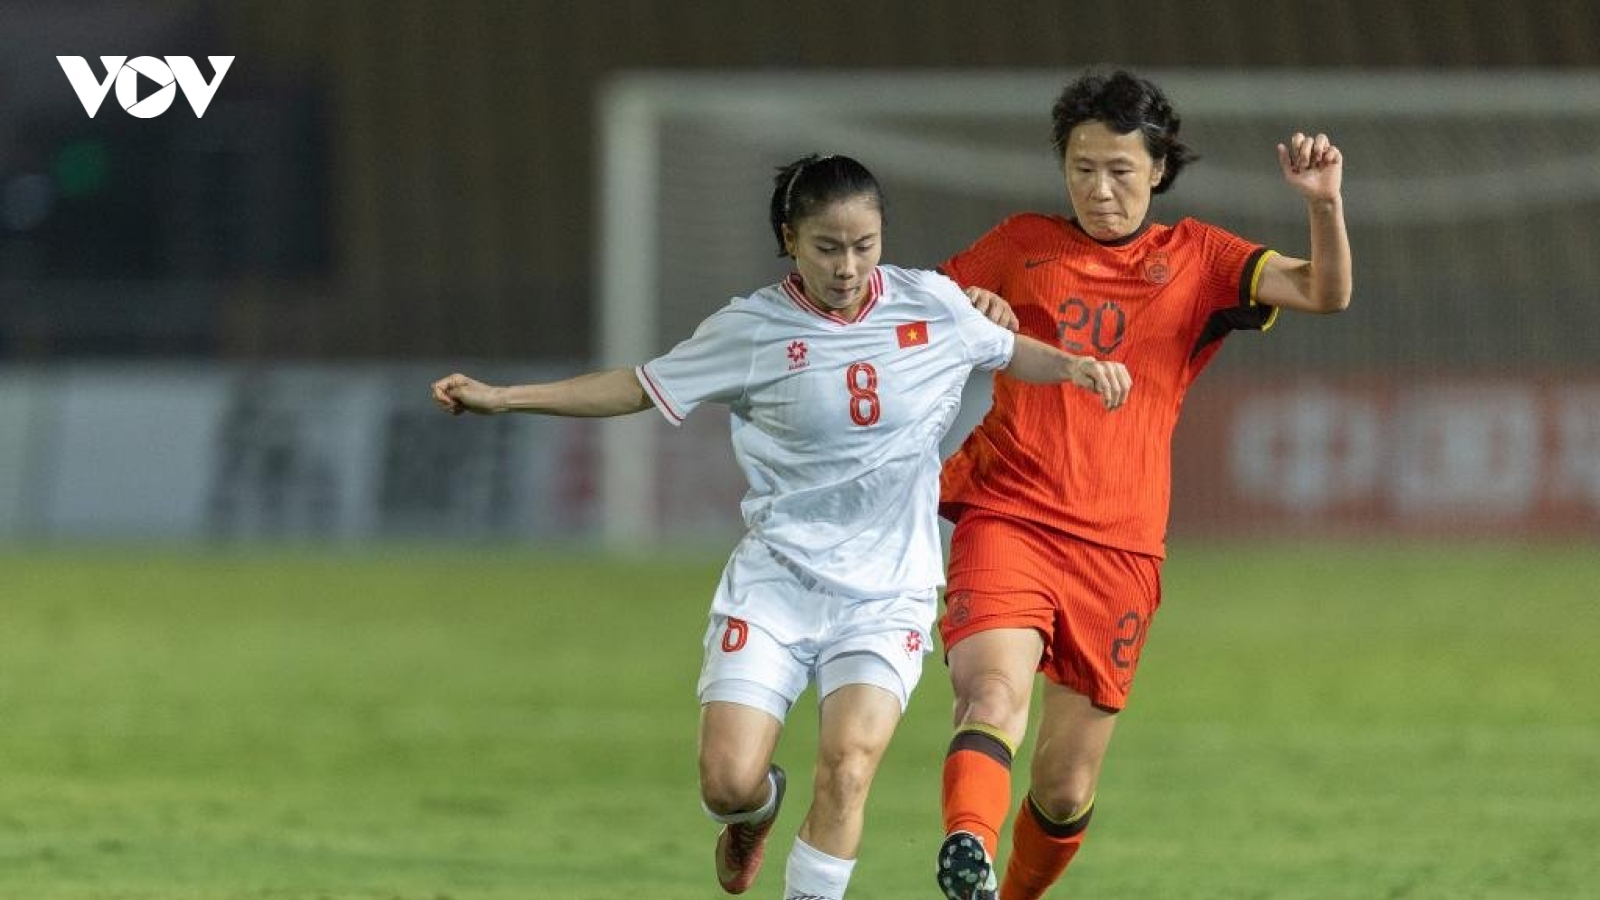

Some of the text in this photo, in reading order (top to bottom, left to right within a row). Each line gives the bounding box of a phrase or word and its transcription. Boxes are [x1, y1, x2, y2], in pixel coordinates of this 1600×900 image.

[1057, 297, 1126, 355] 20
[846, 362, 881, 427] 8
[1110, 610, 1149, 669] 2
